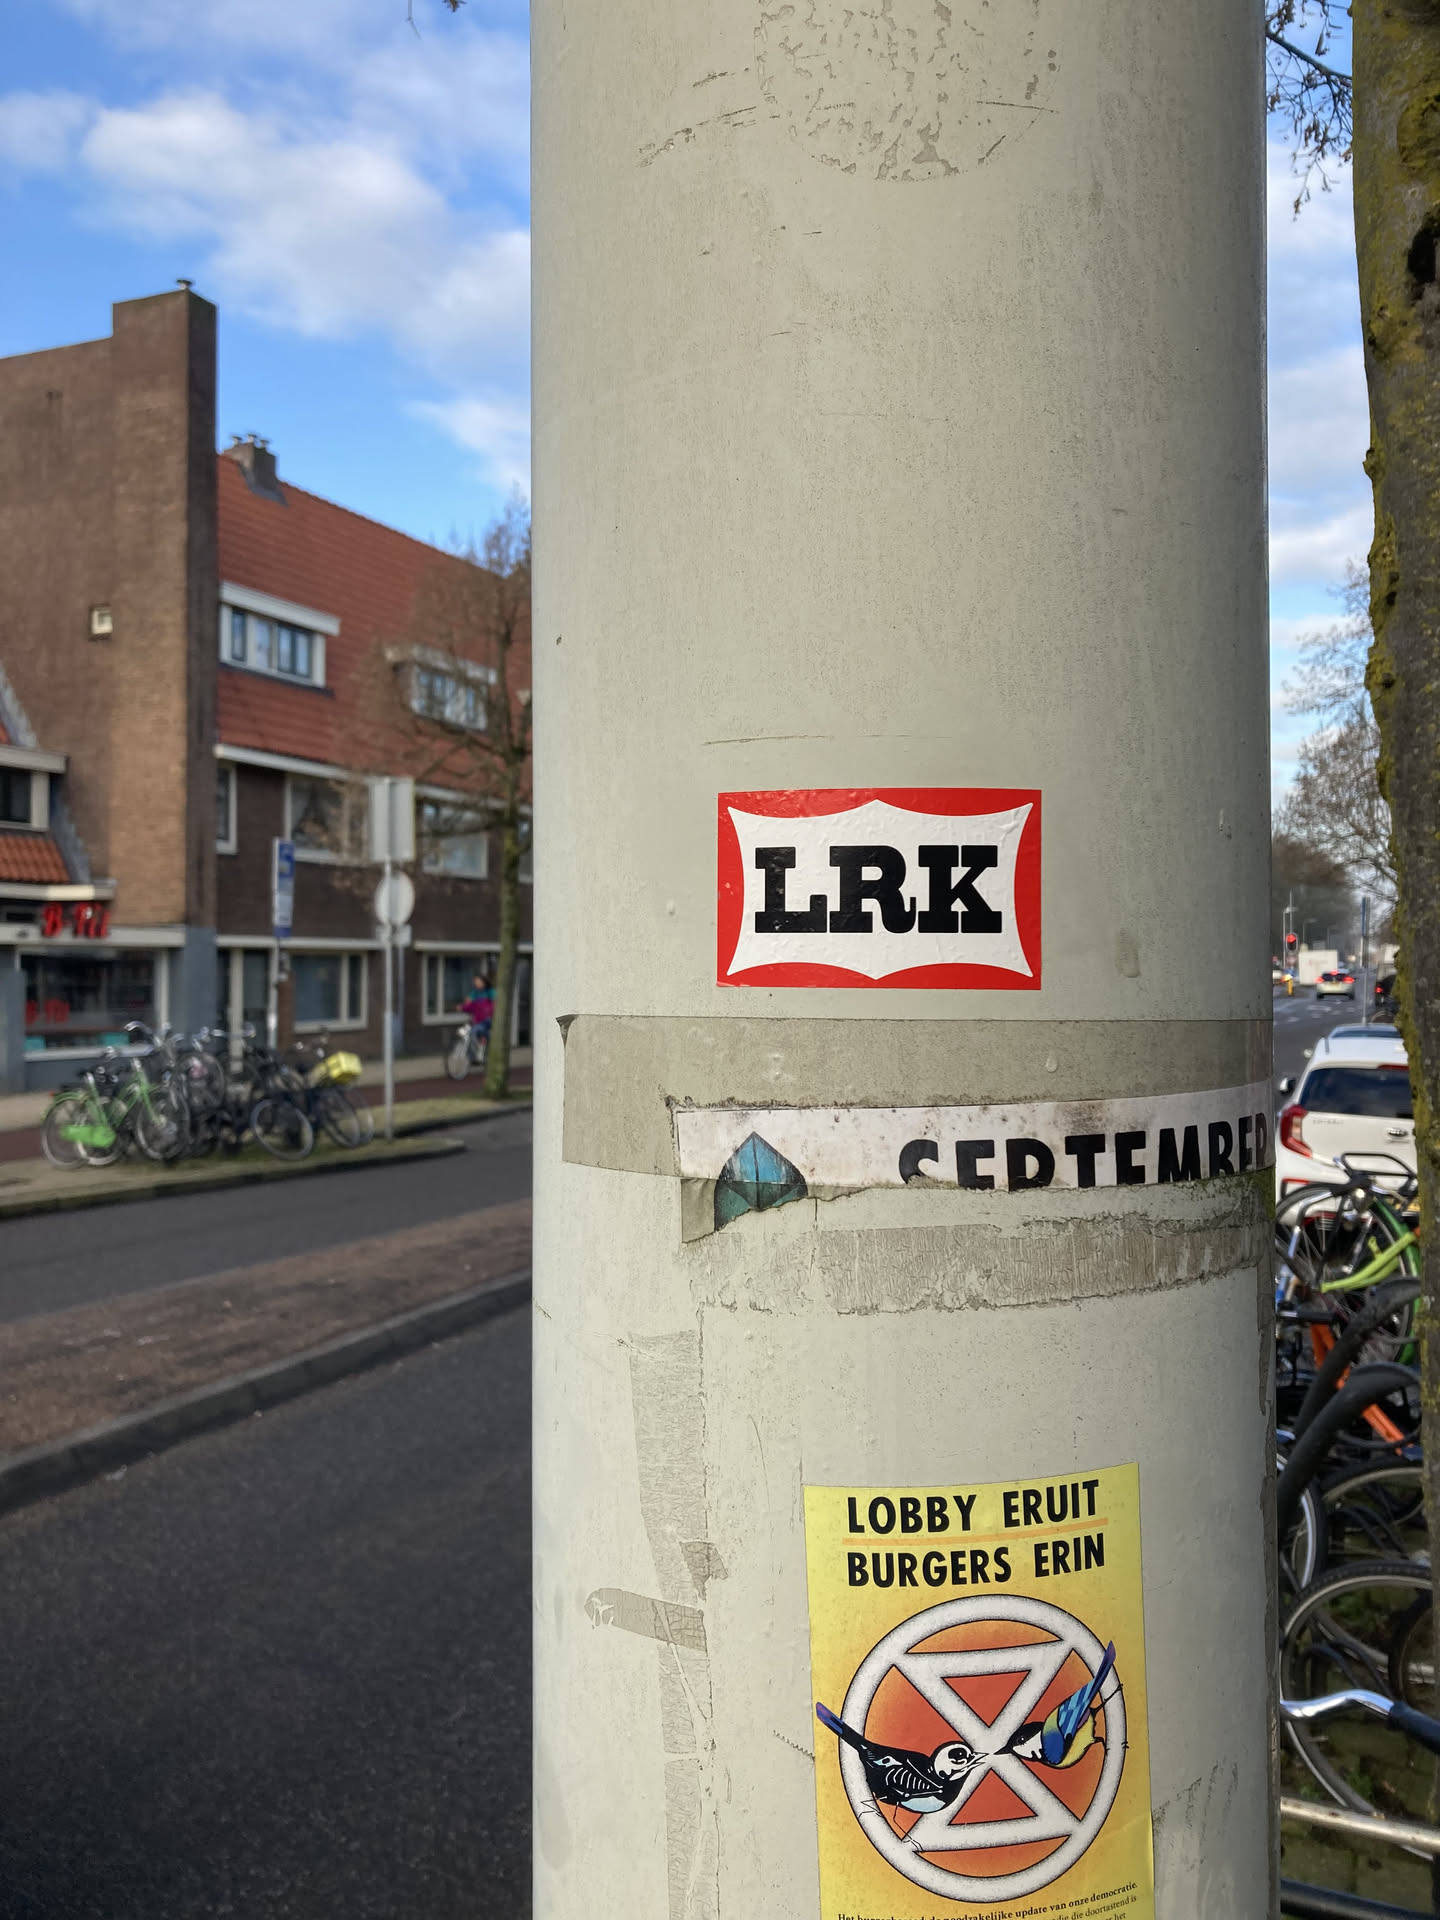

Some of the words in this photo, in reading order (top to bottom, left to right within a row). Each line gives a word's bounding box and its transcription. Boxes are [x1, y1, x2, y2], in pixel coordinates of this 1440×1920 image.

[755, 845, 1002, 933] LRK
[847, 1493, 977, 1535] LOBBY
[1003, 1479, 1099, 1529] ERUIT
[847, 1546, 1012, 1588] BURGERS
[1034, 1532, 1105, 1579] ERIN
[1015, 1906, 1048, 1918] update
[1049, 1902, 1067, 1911] van
[1069, 1897, 1089, 1908] onze
[1085, 1896, 1129, 1917] doortastend
